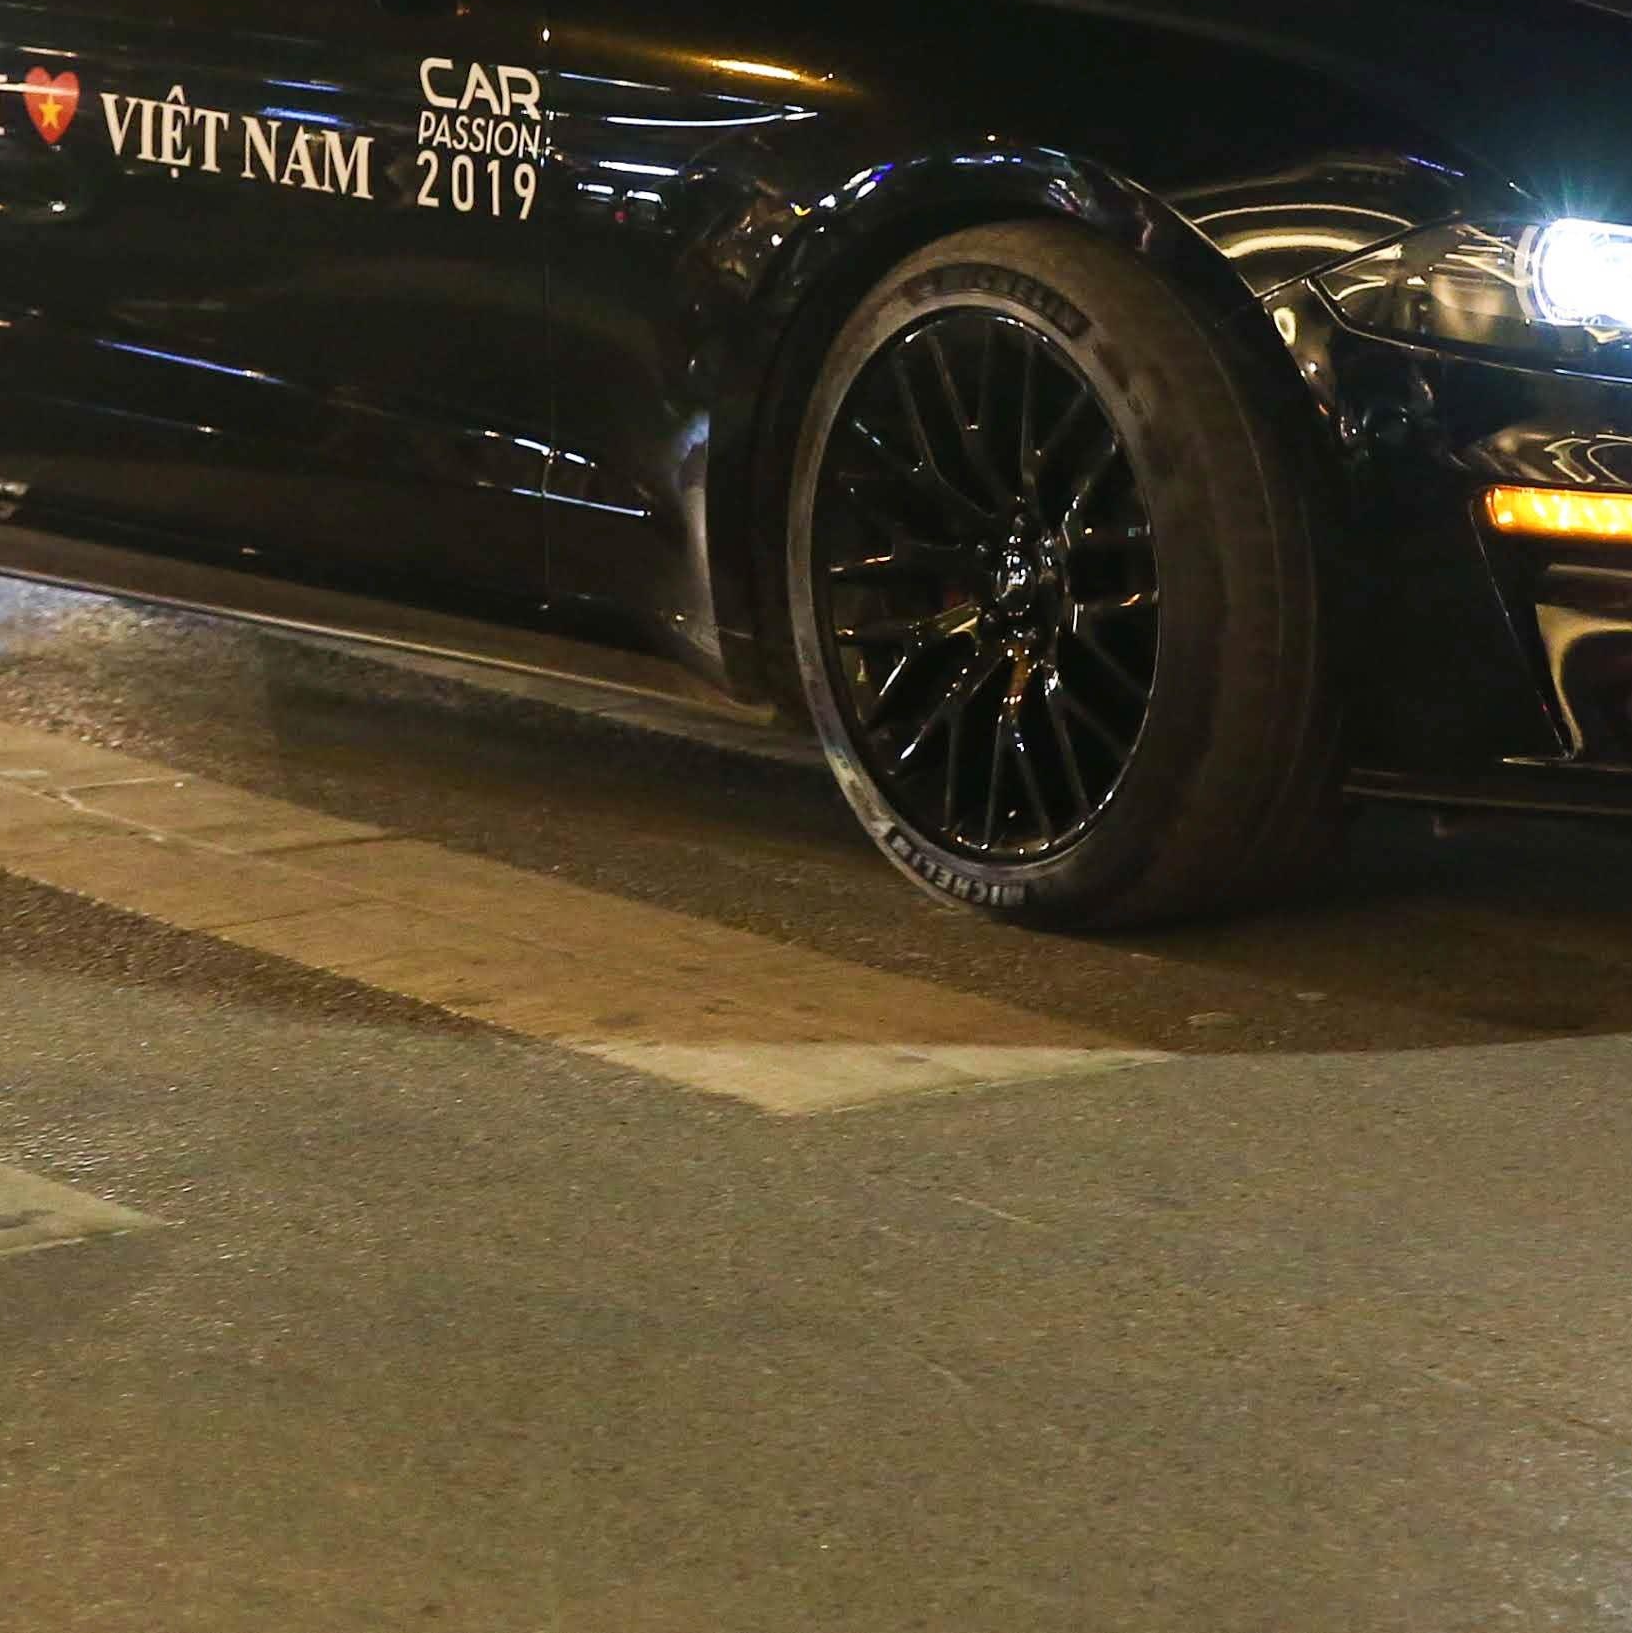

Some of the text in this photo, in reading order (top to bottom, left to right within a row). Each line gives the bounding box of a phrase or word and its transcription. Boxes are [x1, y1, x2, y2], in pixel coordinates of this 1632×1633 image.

[419, 57, 541, 120] CAR
[100, 84, 228, 179] VIỆT
[240, 114, 374, 201] NAM
[417, 113, 542, 159] PASSION
[416, 150, 537, 221] 2019
